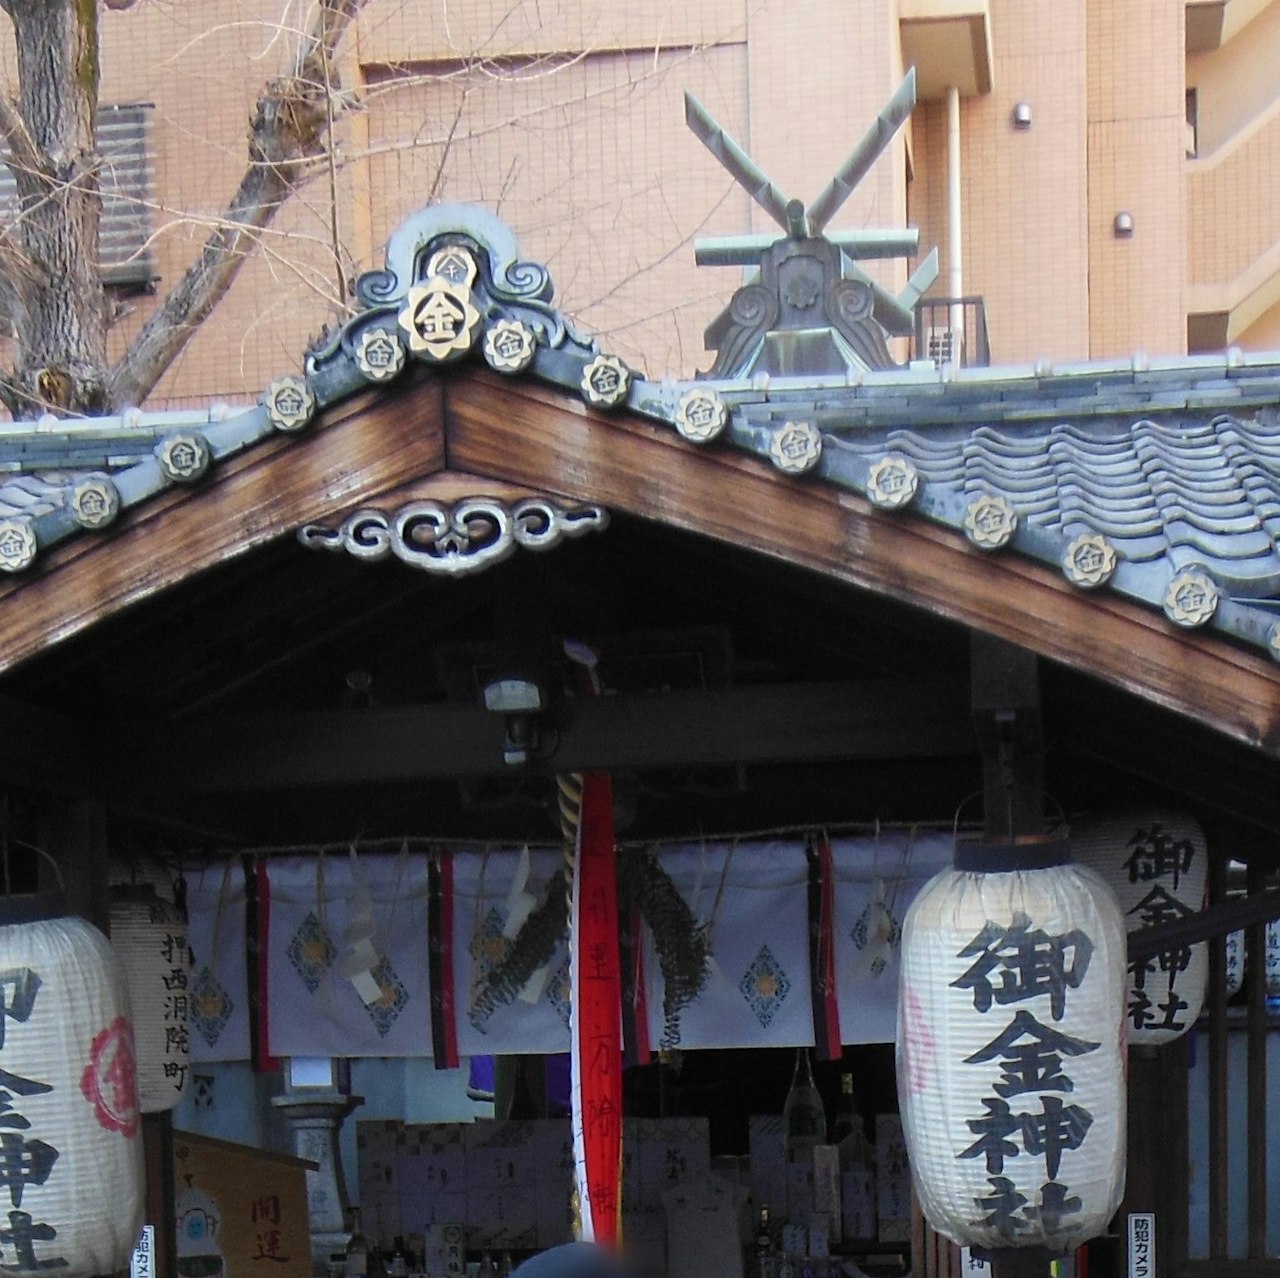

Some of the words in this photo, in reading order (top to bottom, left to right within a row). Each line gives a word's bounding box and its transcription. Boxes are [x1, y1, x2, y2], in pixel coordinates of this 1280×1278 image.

[414, 290, 465, 340] 金
[1121, 822, 1195, 1032] 御金神社
[948, 910, 1102, 1240] 御金神社
